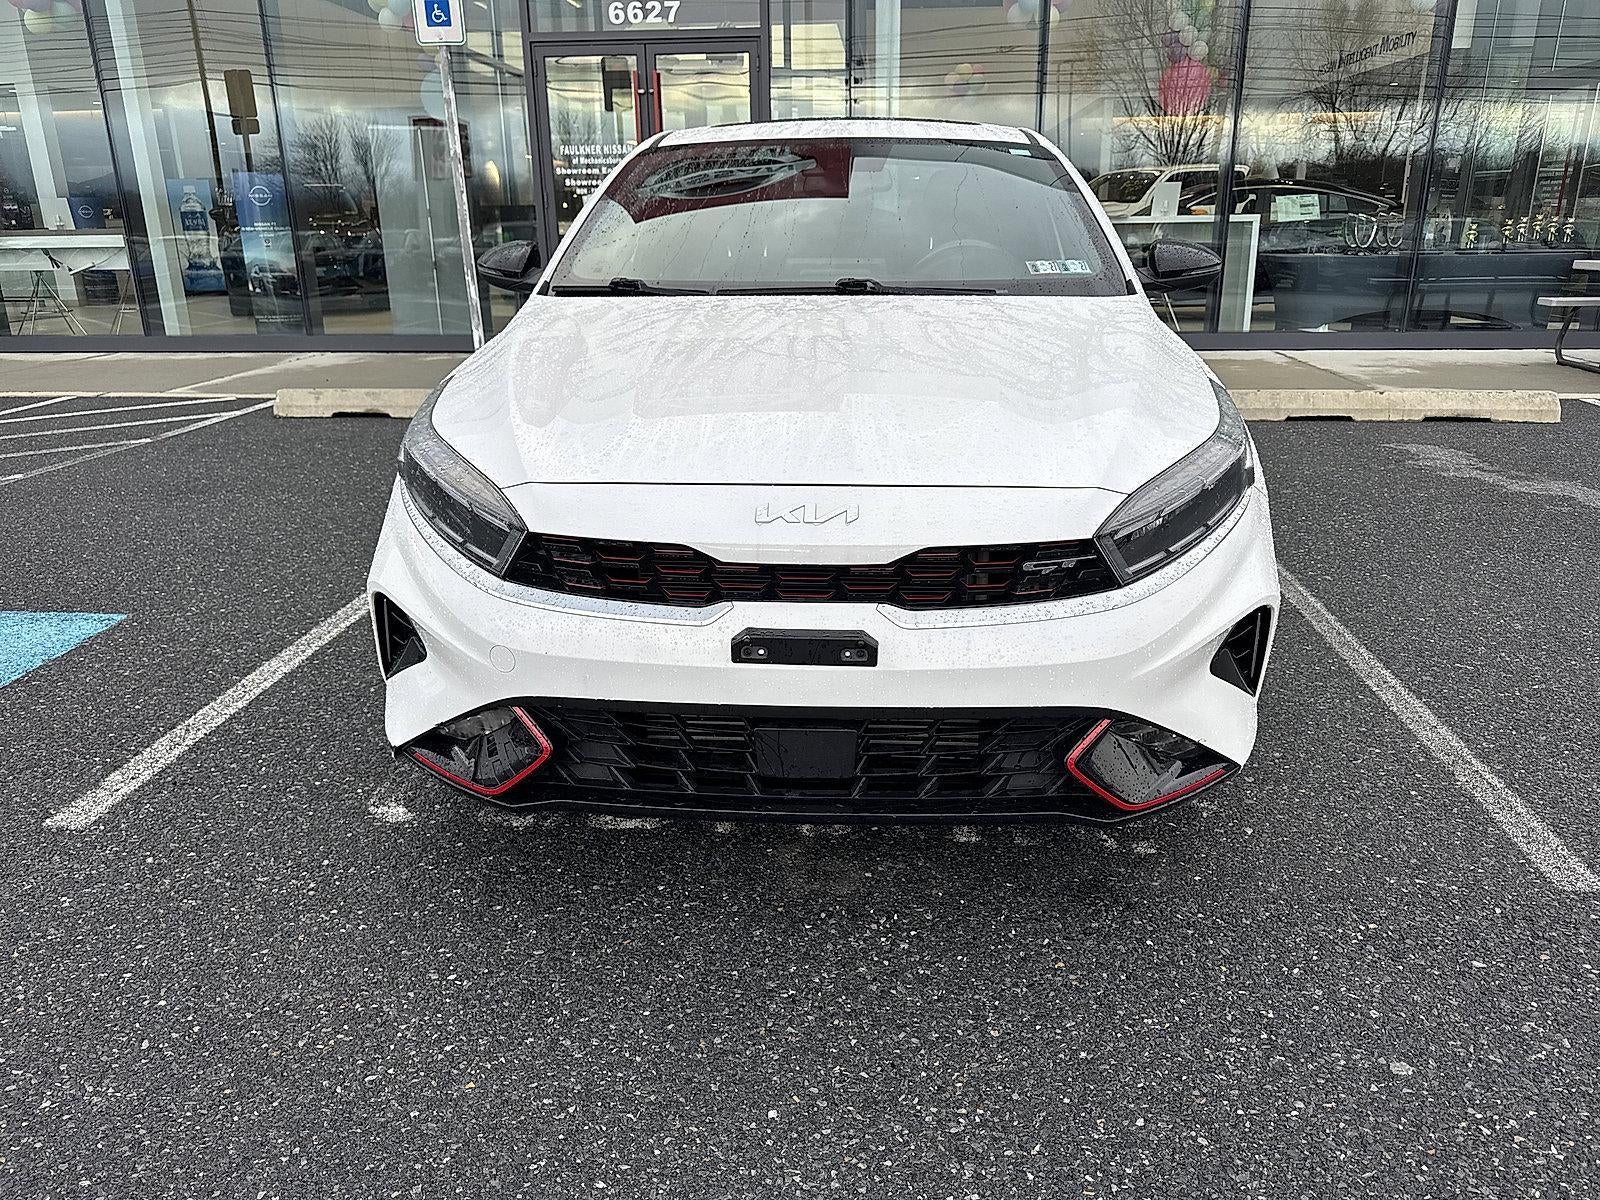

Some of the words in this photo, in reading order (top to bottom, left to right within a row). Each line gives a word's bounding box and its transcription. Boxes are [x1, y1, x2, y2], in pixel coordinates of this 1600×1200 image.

[608, 0, 681, 25] 6627
[560, 144, 602, 155] FAULKNER
[555, 166, 600, 175] Showroom
[564, 178, 603, 187] Showroo
[754, 502, 860, 526] KIA
